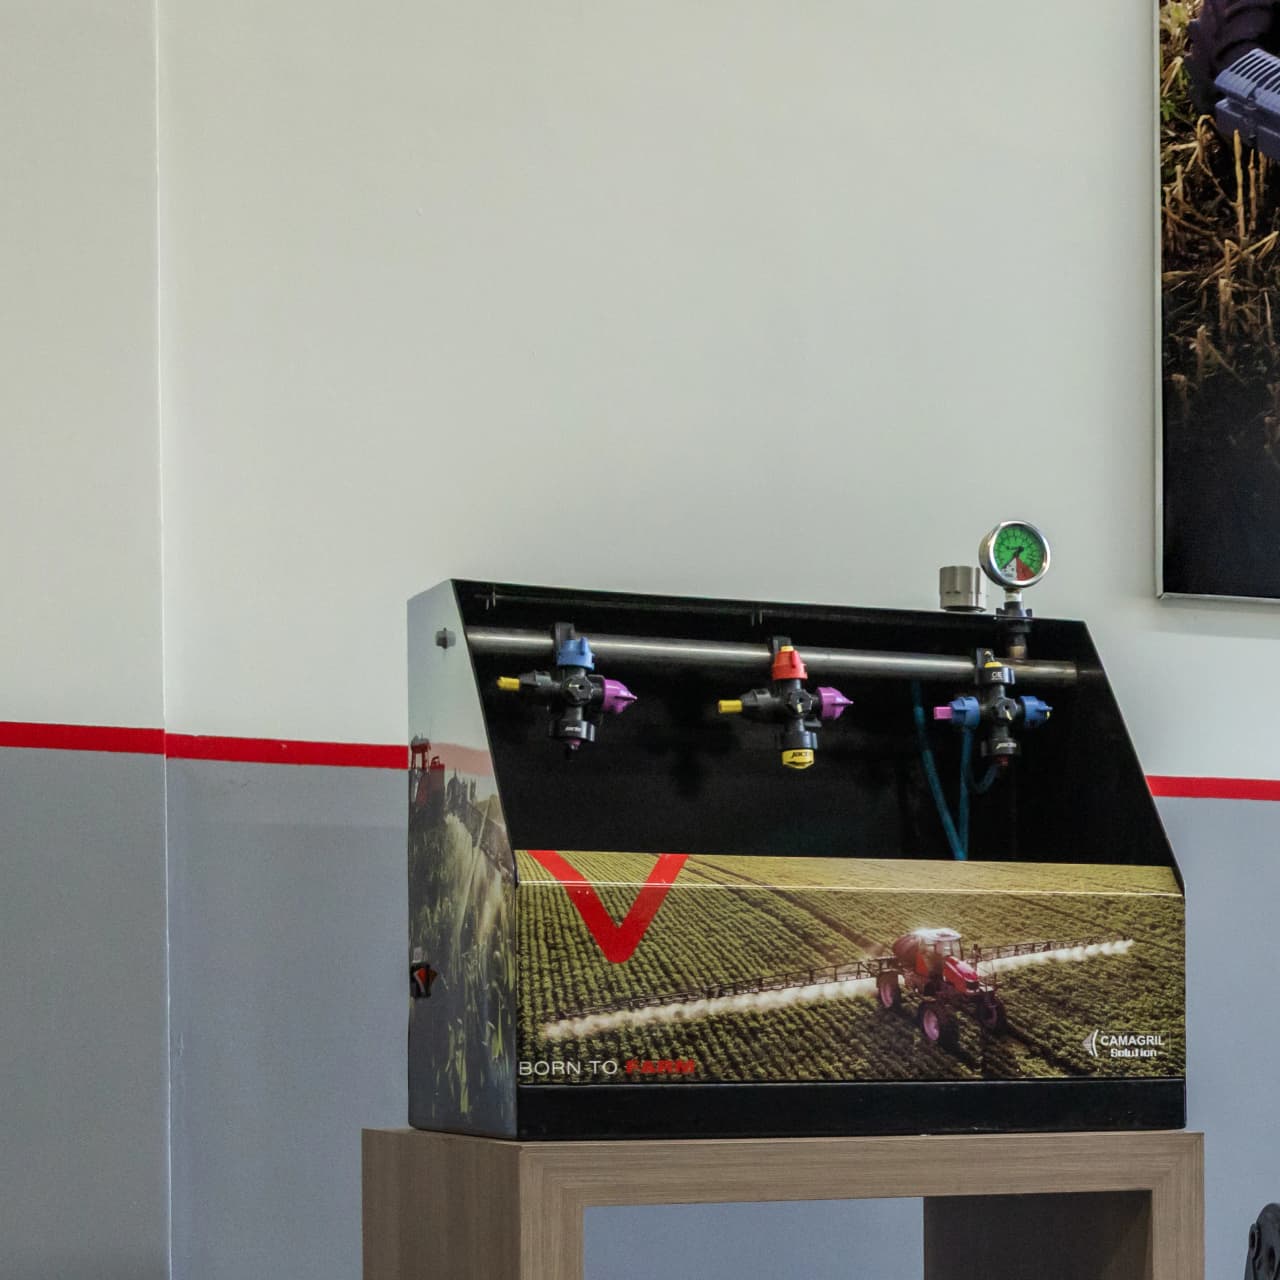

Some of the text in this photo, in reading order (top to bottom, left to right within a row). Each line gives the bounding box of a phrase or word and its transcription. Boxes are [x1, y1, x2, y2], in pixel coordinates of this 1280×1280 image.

[1100, 1035, 1165, 1046] CAMAGRIL
[519, 1059, 695, 1076] BORN TO FARM
